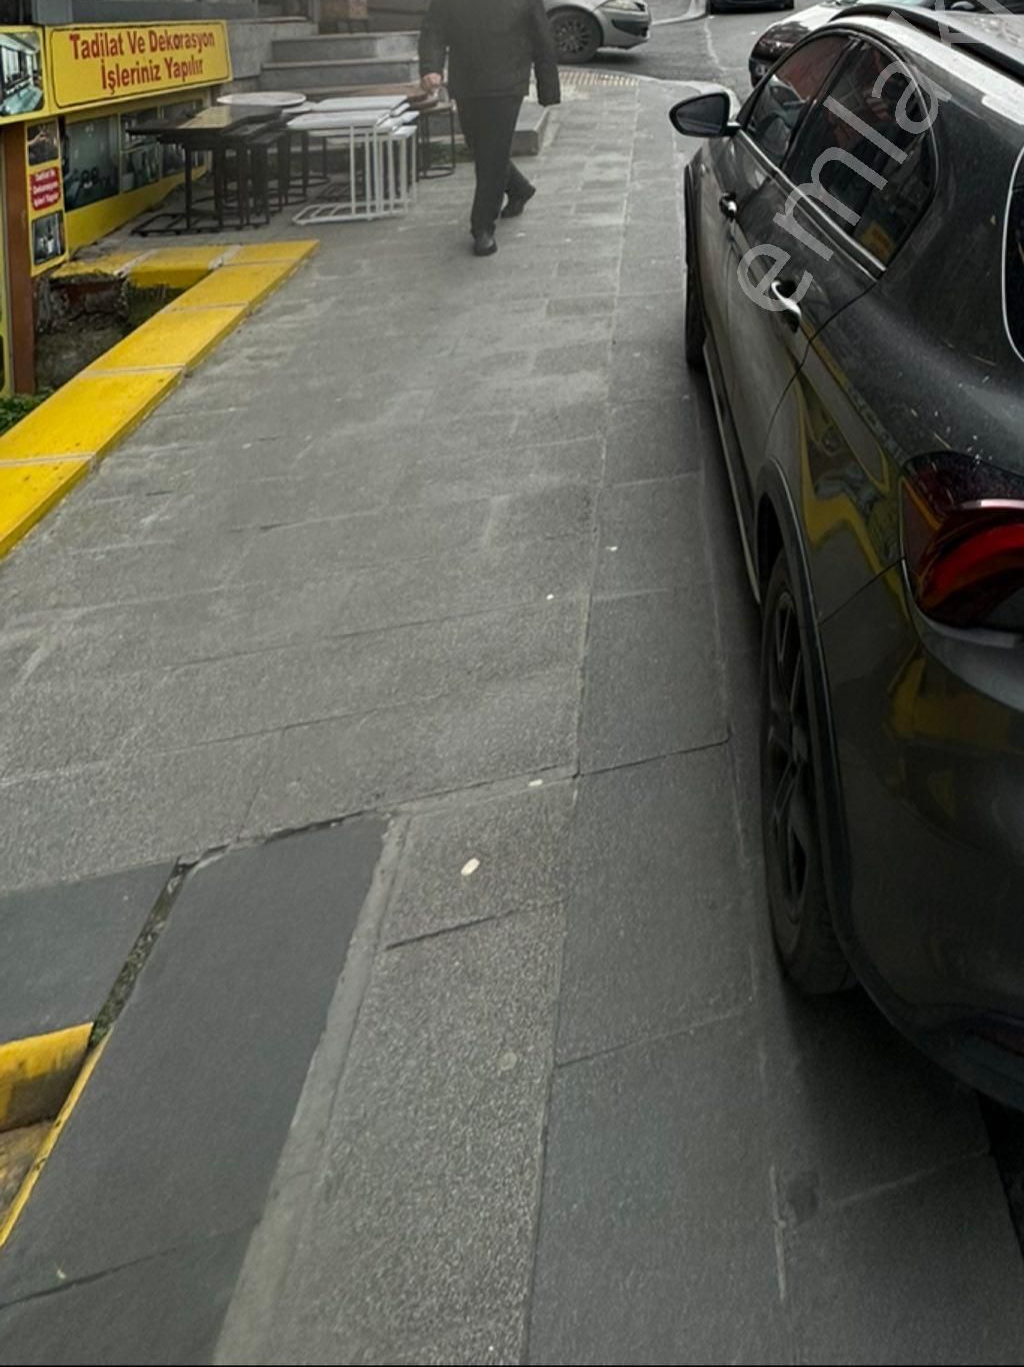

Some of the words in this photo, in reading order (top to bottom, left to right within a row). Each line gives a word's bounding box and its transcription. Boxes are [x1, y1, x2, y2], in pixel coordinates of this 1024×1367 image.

[69, 31, 124, 60] Tadilat
[126, 30, 146, 55] Ve
[149, 29, 215, 54] Dekorasyon
[100, 59, 161, 95] İşleriniz
[164, 54, 203, 82] Yapılır
